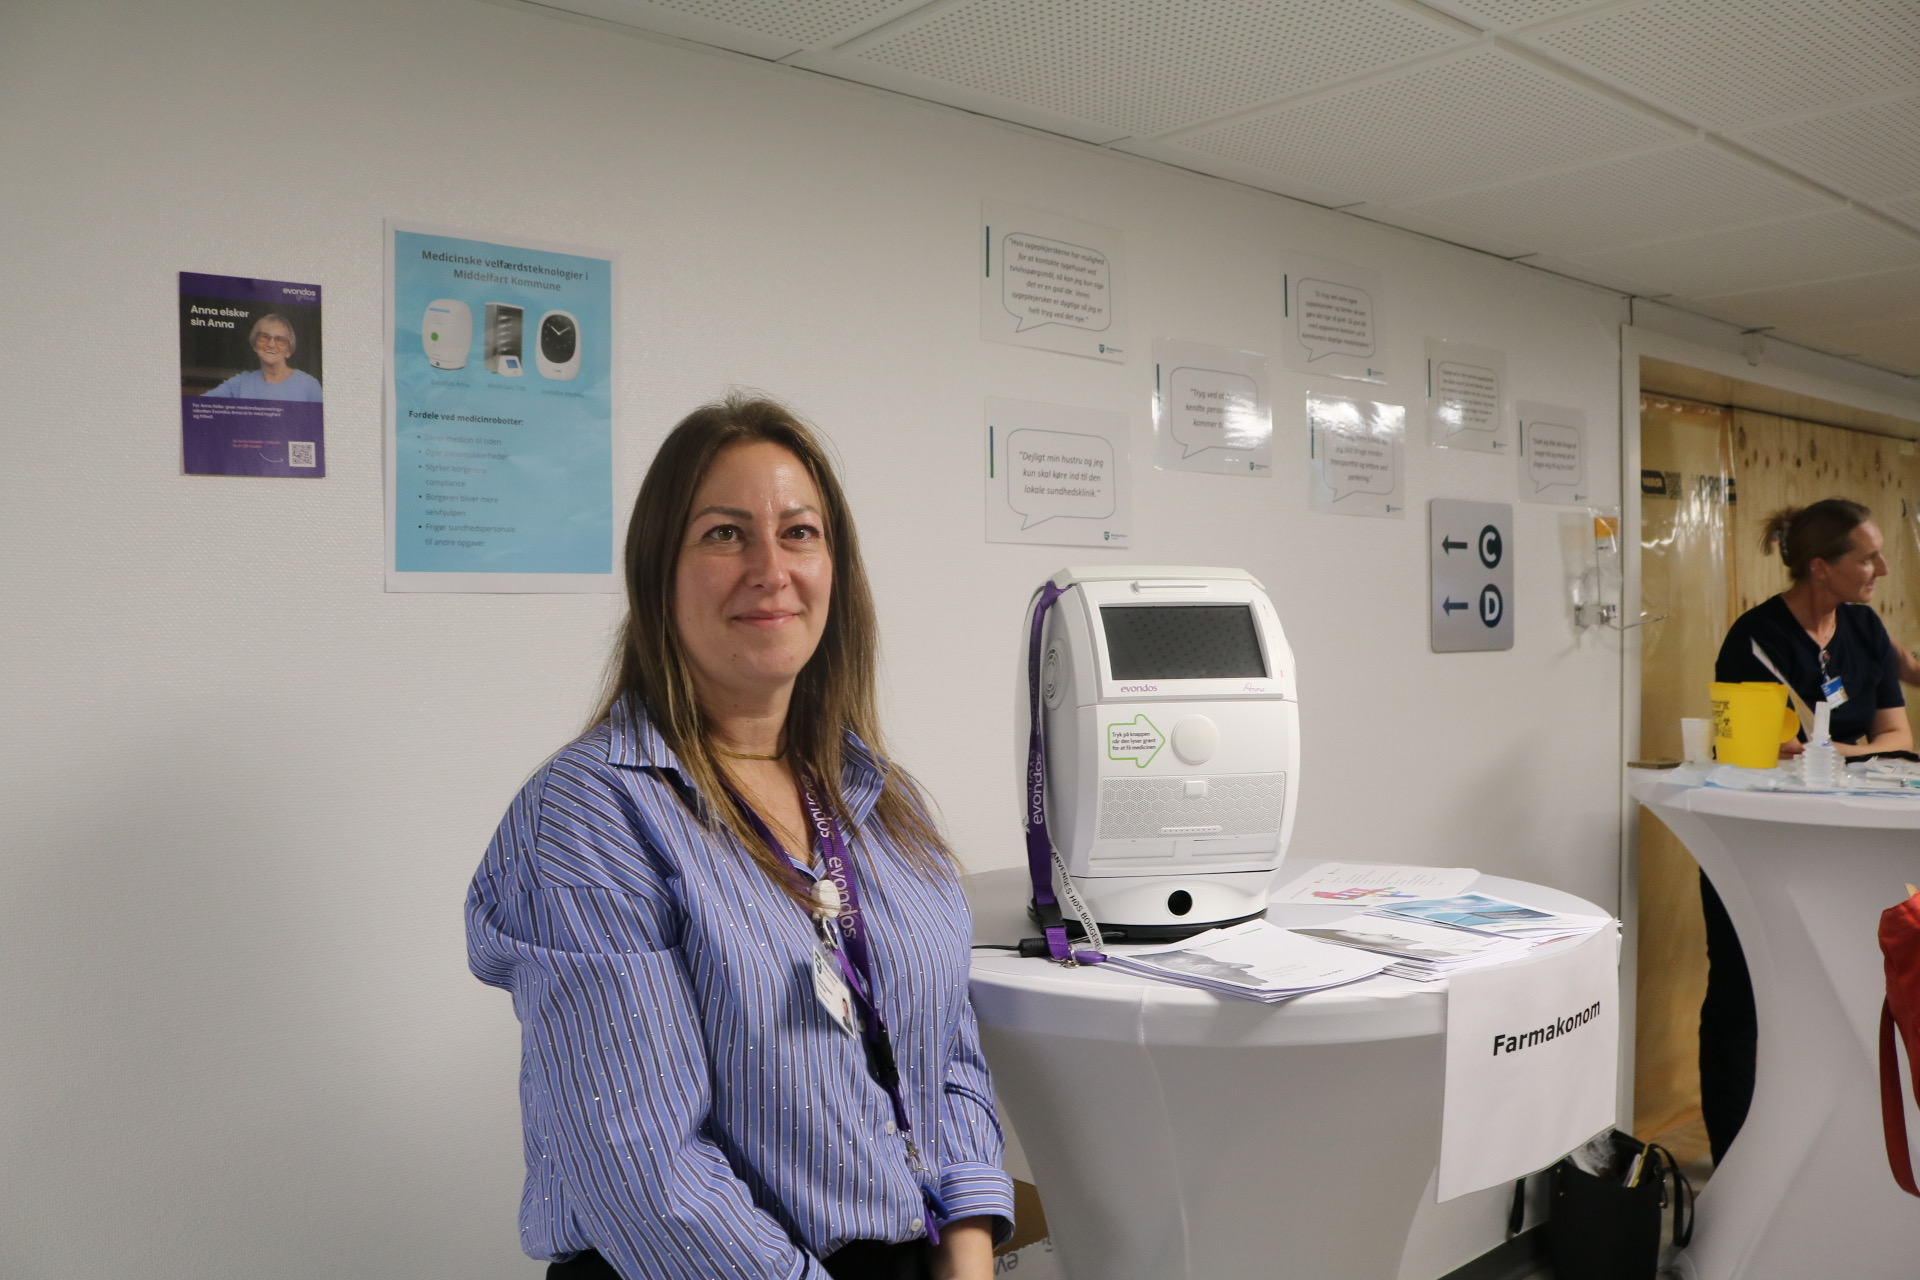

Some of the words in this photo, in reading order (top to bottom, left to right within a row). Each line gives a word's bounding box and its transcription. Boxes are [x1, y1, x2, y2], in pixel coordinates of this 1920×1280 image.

[1017, 252, 1027, 261] for
[422, 250, 482, 266] Medicinske
[485, 258, 583, 281] velfærdsteknologier
[585, 271, 589, 281] i
[453, 269, 508, 285] Middelfart
[511, 276, 561, 292] Kommune
[1074, 277, 1082, 286] jeg
[282, 287, 316, 297] evondos
[190, 305, 218, 316] Anna
[220, 308, 249, 318] elsker
[1029, 306, 1040, 315] helt
[1041, 308, 1053, 318] tryg
[1054, 311, 1064, 319] ved
[1088, 306, 1096, 314] jeg
[191, 318, 206, 327] sin
[208, 319, 235, 329] Anna
[1207, 391, 1218, 399] ved
[1218, 392, 1225, 400] at
[1185, 402, 1205, 412] kendte
[409, 410, 439, 420] Fordele
[440, 413, 455, 421] ved
[457, 414, 524, 426] medicinrobotter:
[1193, 418, 1217, 428] kommer
[1047, 455, 1060, 463] min
[1061, 457, 1082, 465] hustru
[1084, 459, 1093, 467] og
[1093, 458, 1104, 468] jeg
[1023, 468, 1036, 477] kun
[1038, 469, 1050, 478] skal
[1052, 470, 1068, 480] køre
[1069, 472, 1080, 481] ind
[1089, 473, 1101, 482] den
[1024, 485, 1045, 495] lokale
[425, 493, 459, 503] Borgeren
[425, 523, 447, 533] Frigør
[425, 538, 434, 546] til
[434, 538, 456, 546] andre
[457, 540, 485, 549] opgaver
[1482, 531, 1497, 563] C
[1485, 591, 1500, 622] D
[1120, 684, 1158, 693] evondos
[1112, 731, 1122, 739] Tryk
[1130, 731, 1151, 739] knappen
[1033, 752, 1043, 825] evondos
[1051, 851, 1073, 895] ANVENDES
[1069, 894, 1083, 912] HOS
[828, 856, 858, 940] evondos
[1493, 1001, 1600, 1056] Farmakonom
